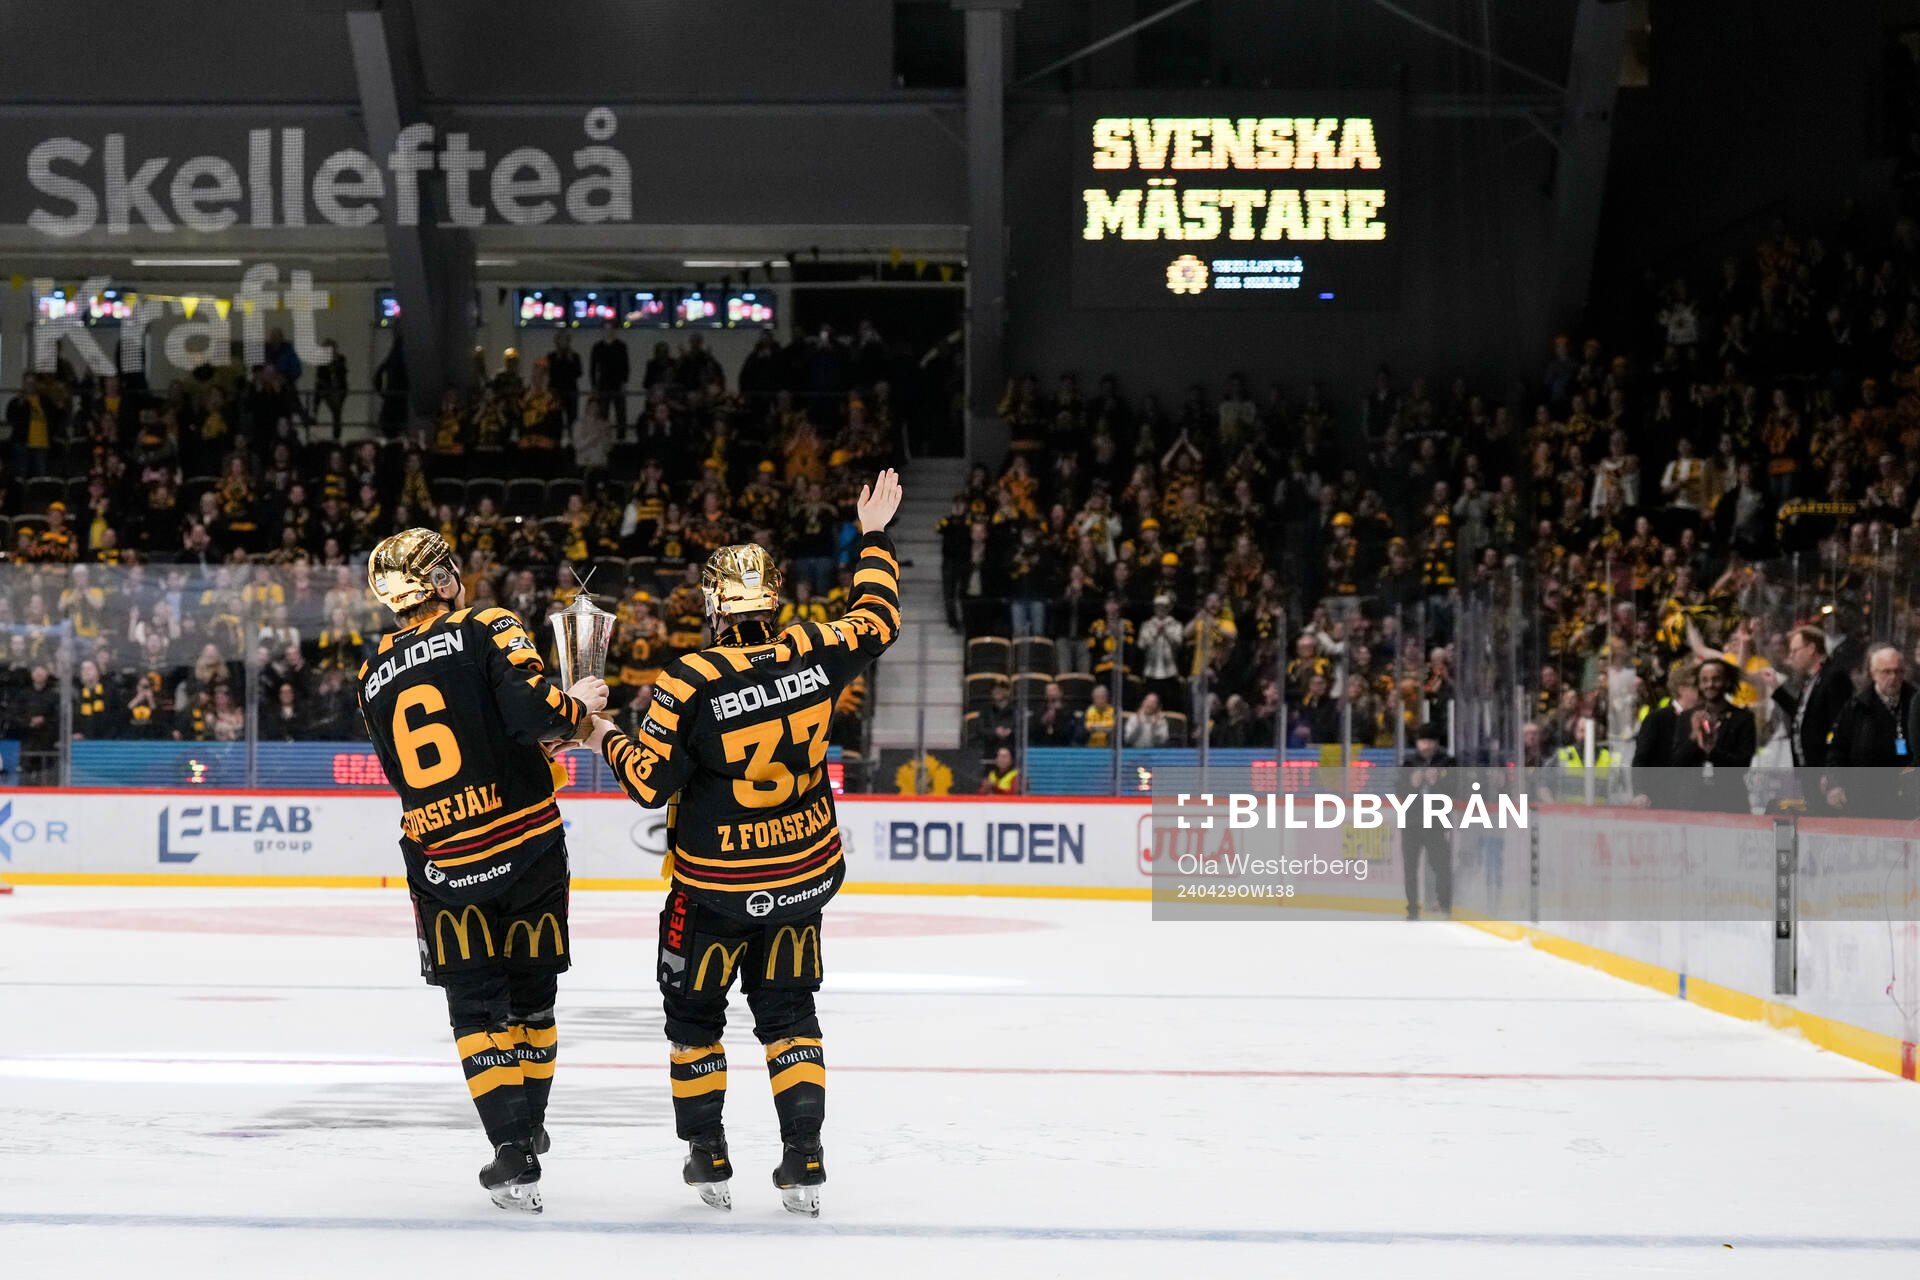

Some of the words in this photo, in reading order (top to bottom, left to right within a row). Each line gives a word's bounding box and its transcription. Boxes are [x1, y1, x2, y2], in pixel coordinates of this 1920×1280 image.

[1093, 117, 1382, 170] SVENSKA
[26, 107, 633, 237] Skellefteå
[1083, 177, 1386, 241] MÄSTARE
[32, 262, 334, 377] Kraft
[367, 629, 464, 700] BOLIDEN
[750, 652, 775, 663] CCM
[710, 697, 724, 722] NEW
[718, 664, 831, 720] BOLIDEN
[392, 684, 462, 789] 6
[721, 697, 833, 809] 33
[210, 805, 313, 833] LEAB
[717, 825, 735, 852] Z
[889, 821, 1085, 864] BOLIDEN
[253, 839, 313, 853] group
[447, 862, 512, 889] ontractor
[777, 876, 834, 908] Contractor
